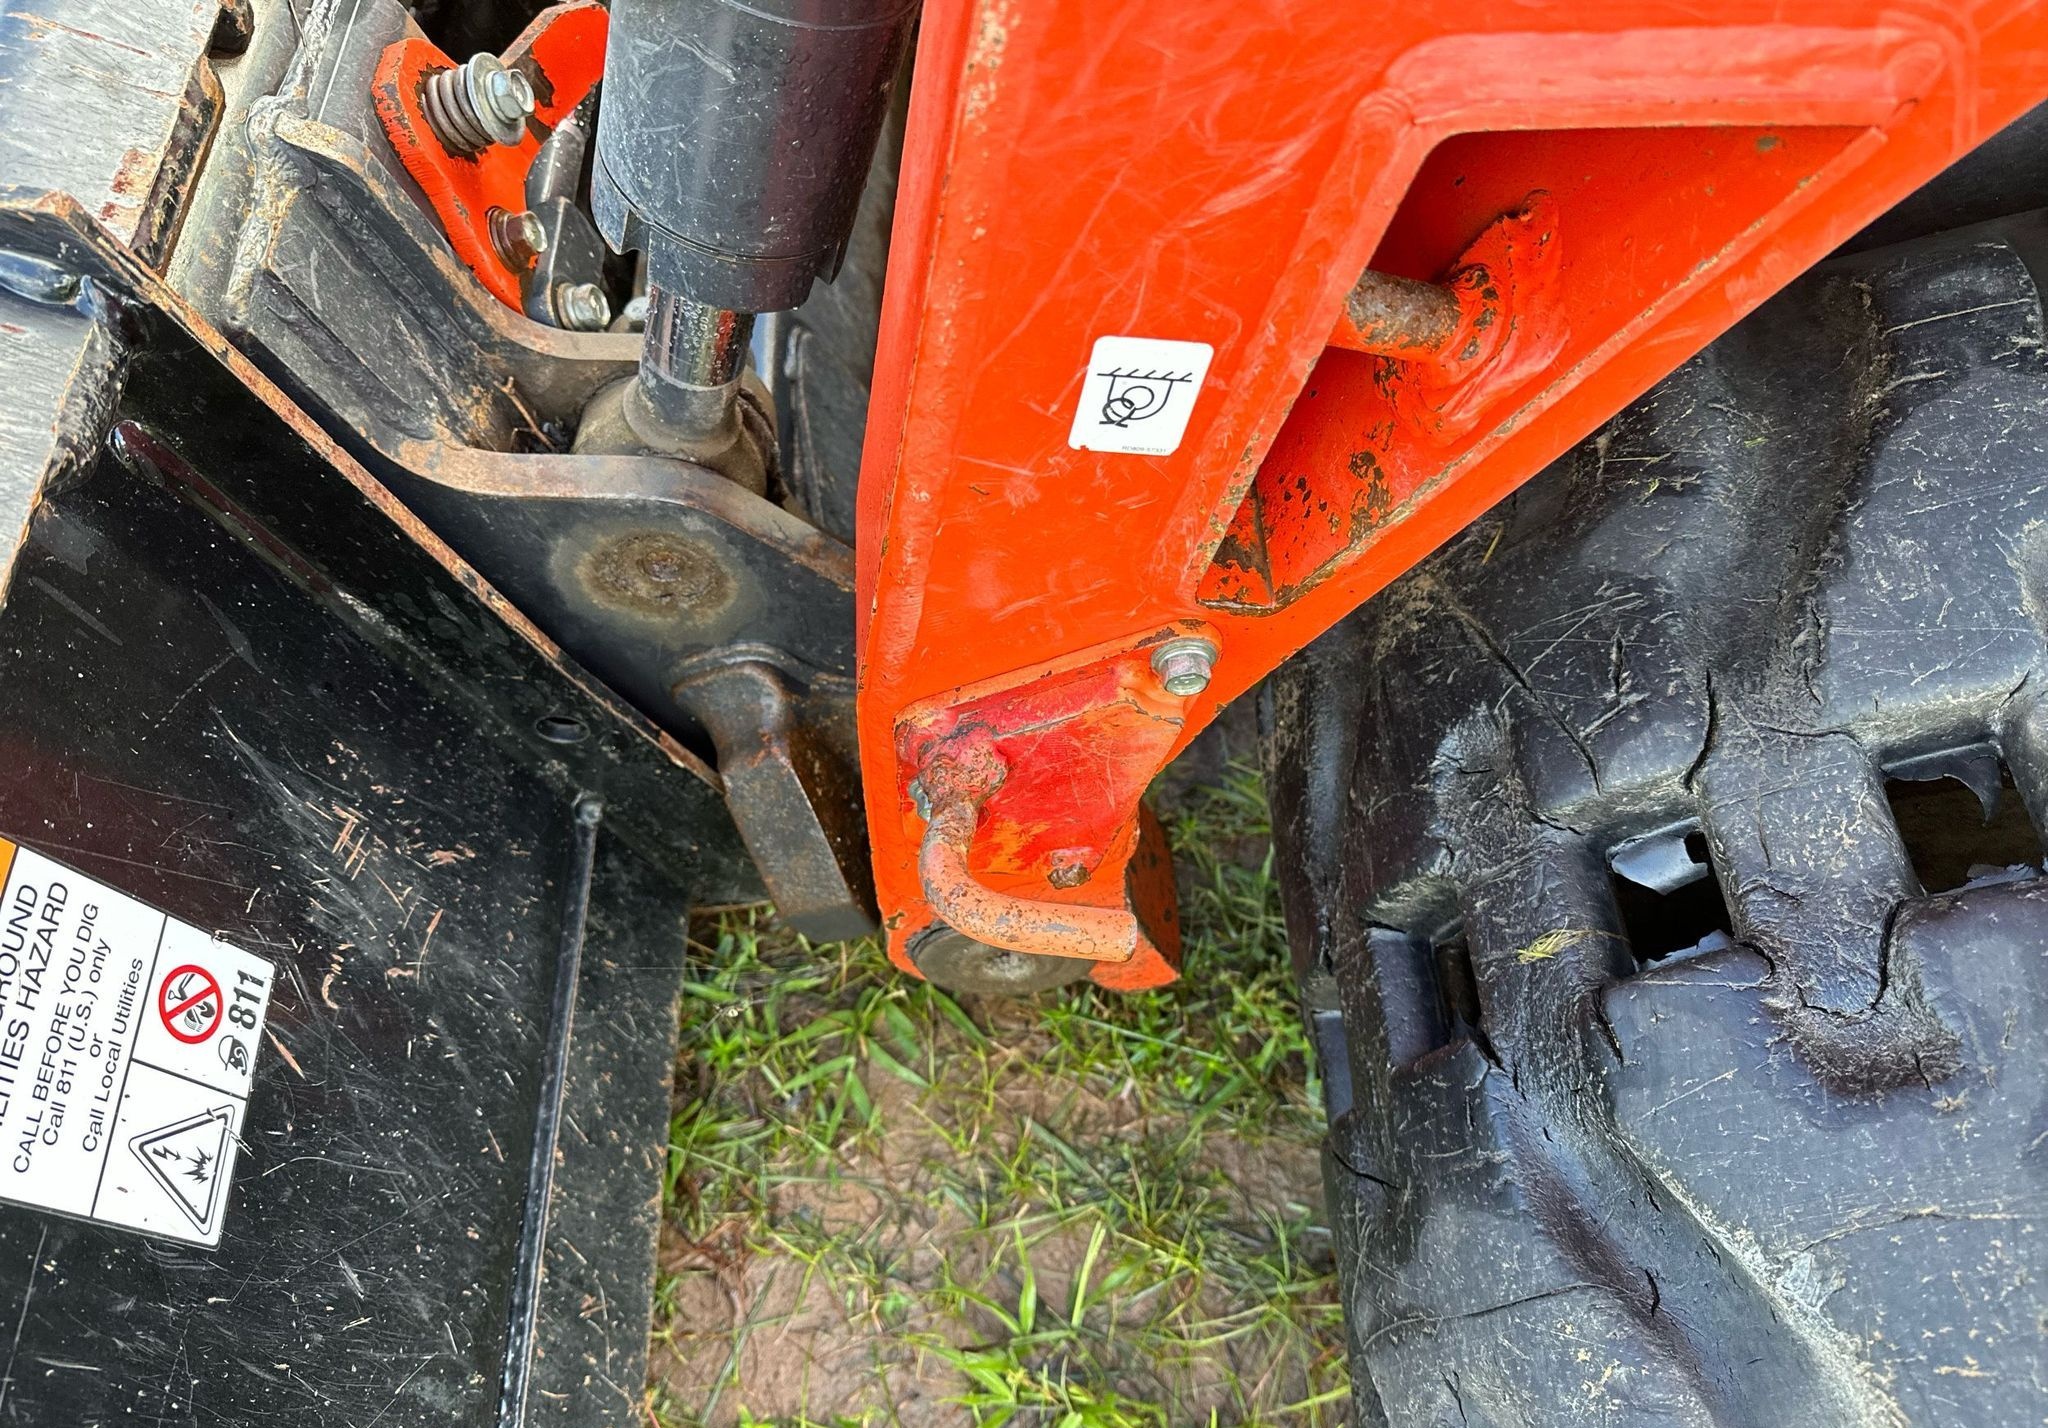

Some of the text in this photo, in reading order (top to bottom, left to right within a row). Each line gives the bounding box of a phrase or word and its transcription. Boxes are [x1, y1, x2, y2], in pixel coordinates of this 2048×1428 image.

[0, 884, 38, 1021] ROUND
[16, 881, 69, 1011] HAZARD
[228, 969, 265, 1031] 811
[13, 903, 99, 1173] CALL BEFORE YOU DIG
[42, 937, 111, 1146] Call 811 (U.S.) only
[82, 958, 143, 1152] Call Local Utilities
[90, 1033, 104, 1058] or
